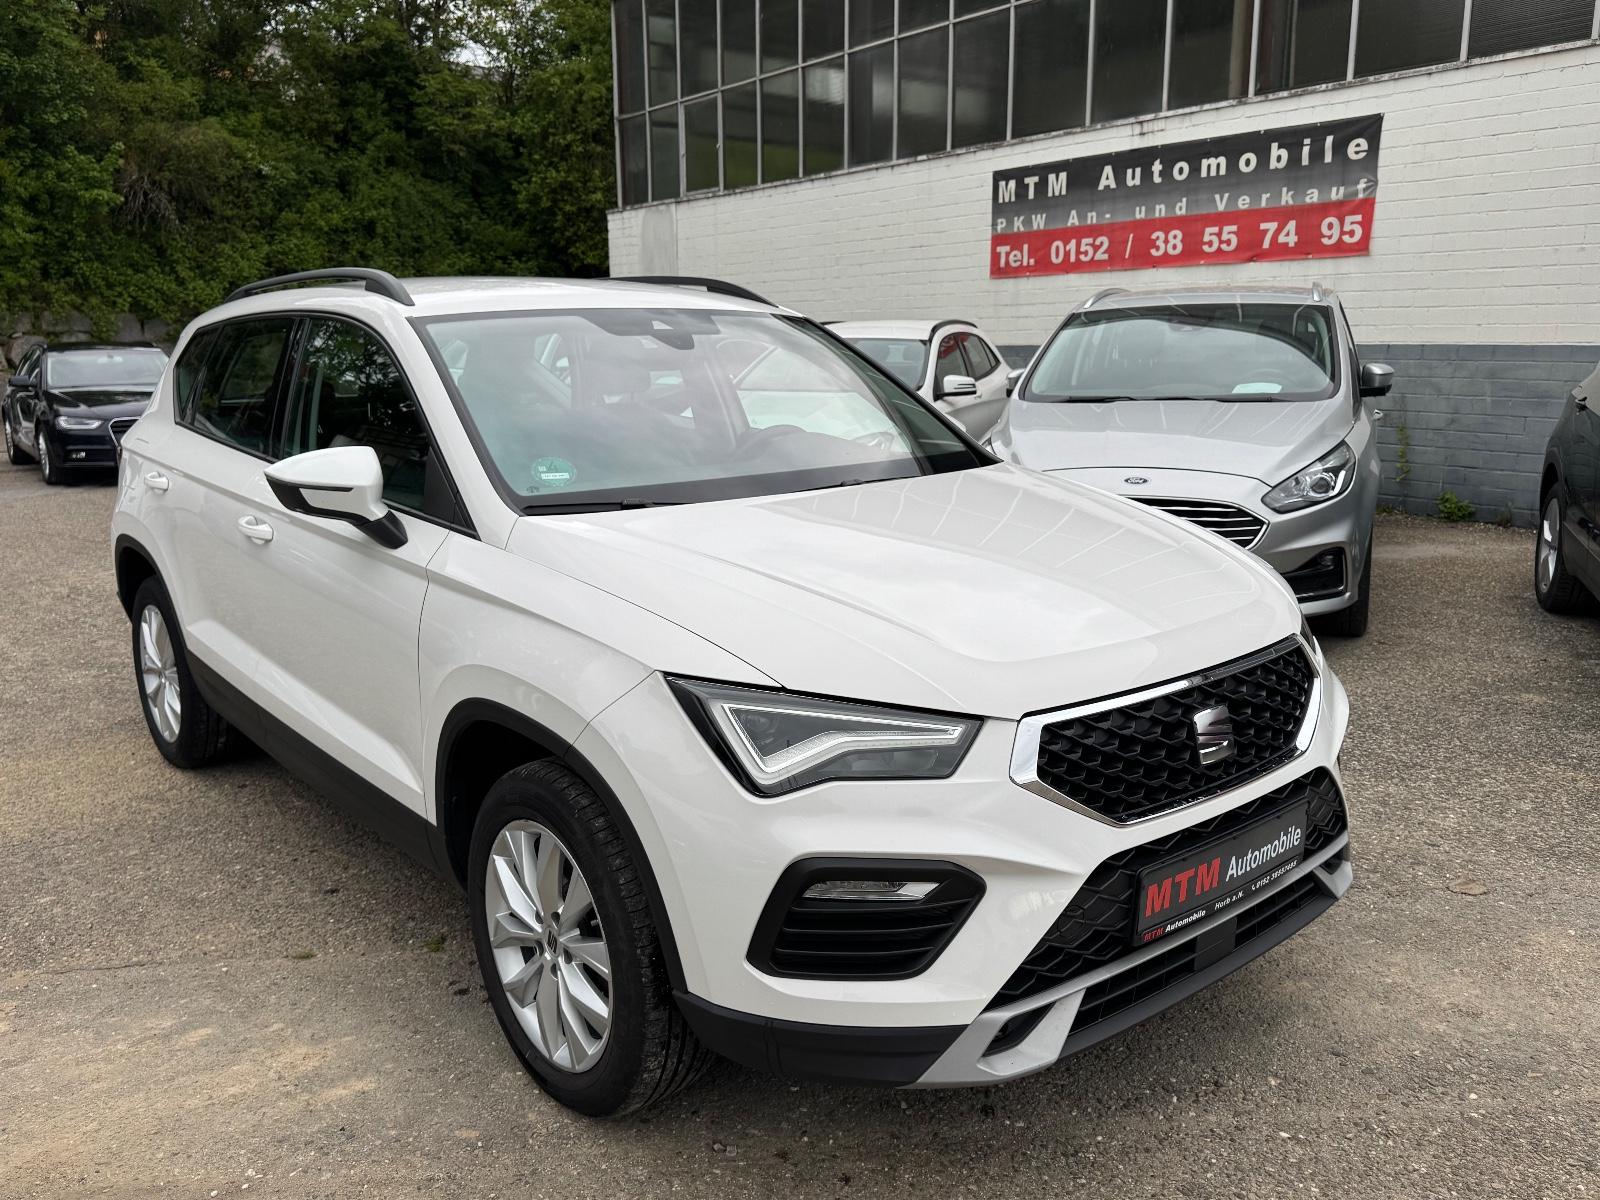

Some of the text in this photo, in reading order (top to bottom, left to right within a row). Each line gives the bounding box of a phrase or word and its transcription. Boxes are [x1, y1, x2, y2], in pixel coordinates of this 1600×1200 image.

[998, 134, 1369, 204] MTM Automobile
[996, 178, 1368, 234] PKW An- und Verkauf
[996, 243, 1035, 268] Tel.
[1050, 236, 1110, 264] 0152
[1150, 229, 1183, 256] 38
[1202, 224, 1238, 253] 55
[1259, 219, 1299, 249] 74
[1320, 214, 1363, 246] 95
[1145, 825, 1301, 918] MTM Automobile
[1164, 909, 1206, 933] Automobile
